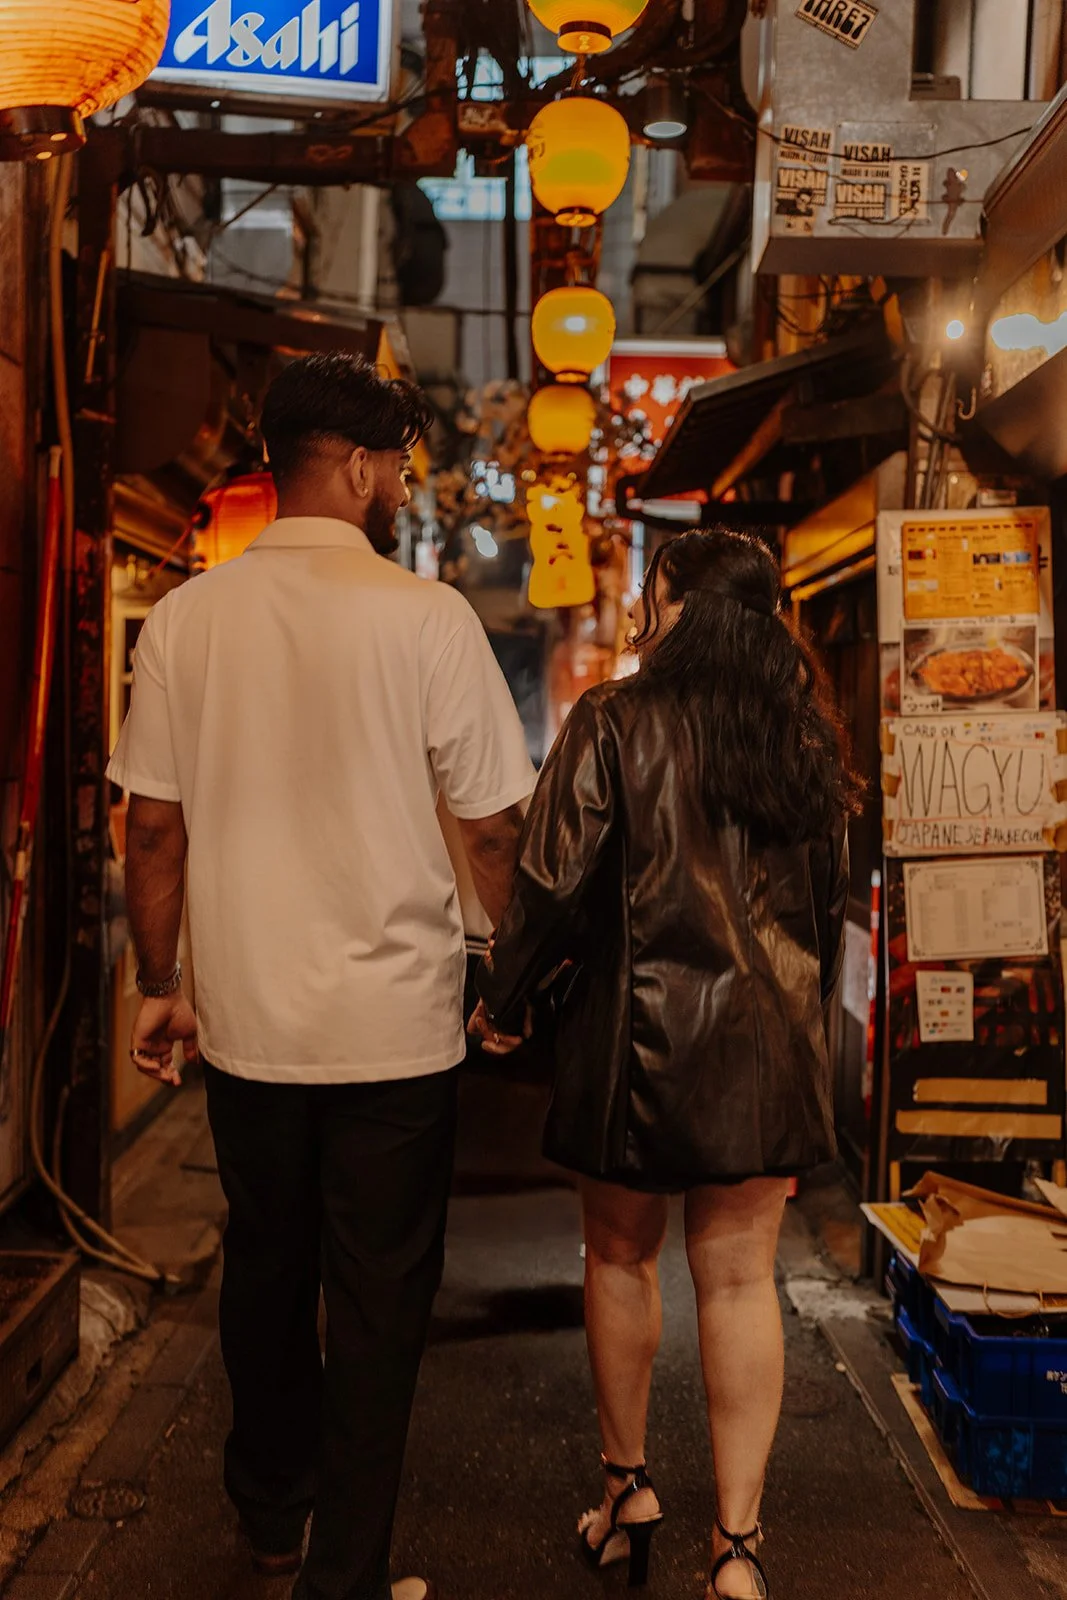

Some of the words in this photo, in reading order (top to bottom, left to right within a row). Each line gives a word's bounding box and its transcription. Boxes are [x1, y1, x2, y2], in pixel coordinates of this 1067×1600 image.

[173, 0, 360, 75] Asahi
[784, 127, 831, 149] VISAH
[843, 145, 891, 163] VISAH
[777, 167, 829, 188] VISAH
[835, 183, 886, 204] VISAH
[903, 723, 938, 738] CARD
[940, 726, 957, 738] OK
[900, 739, 1045, 820] WAGYU
[897, 820, 983, 847] JAPANESE
